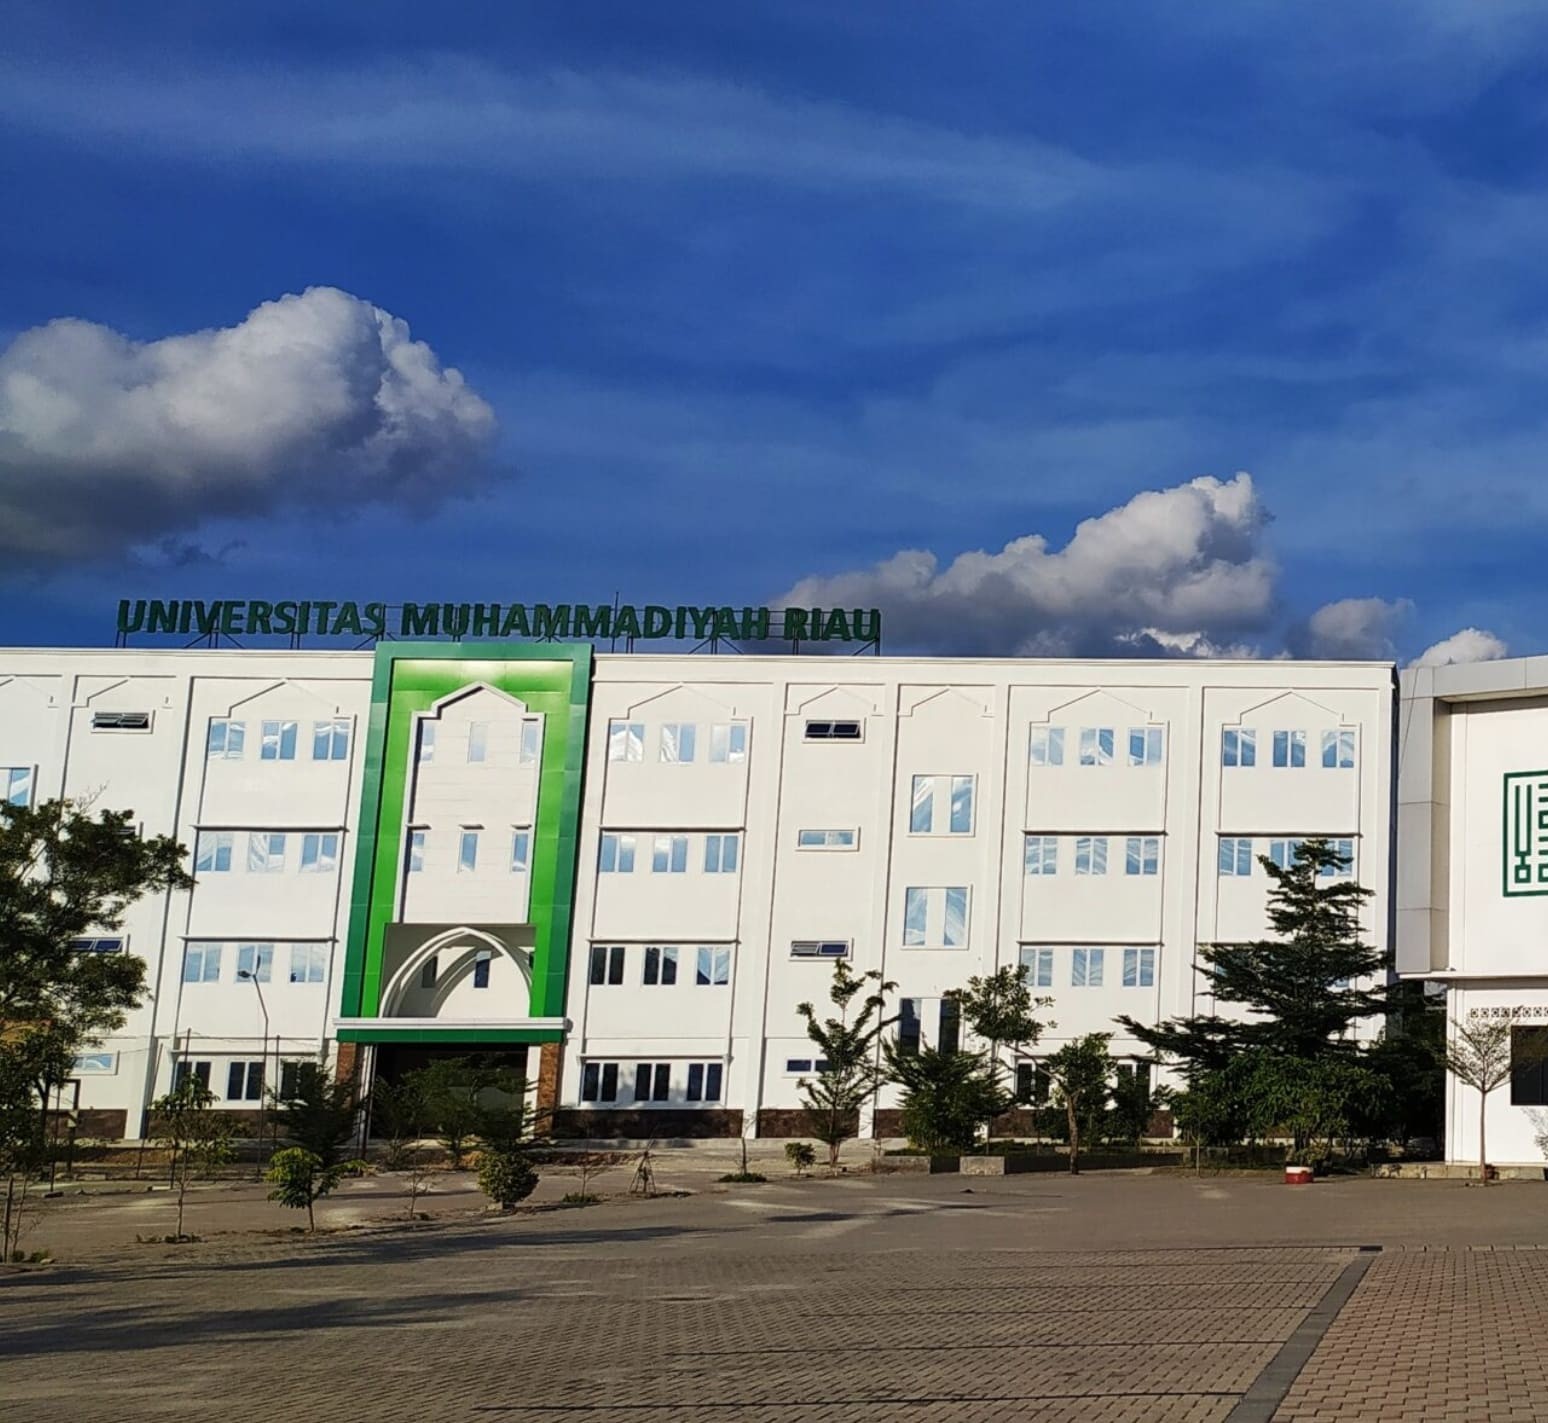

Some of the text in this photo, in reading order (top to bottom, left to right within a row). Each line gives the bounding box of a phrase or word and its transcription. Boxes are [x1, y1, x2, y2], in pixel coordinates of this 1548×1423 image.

[117, 600, 880, 641] UNIVERSITAS MUHAMMADIYAH RIAU
